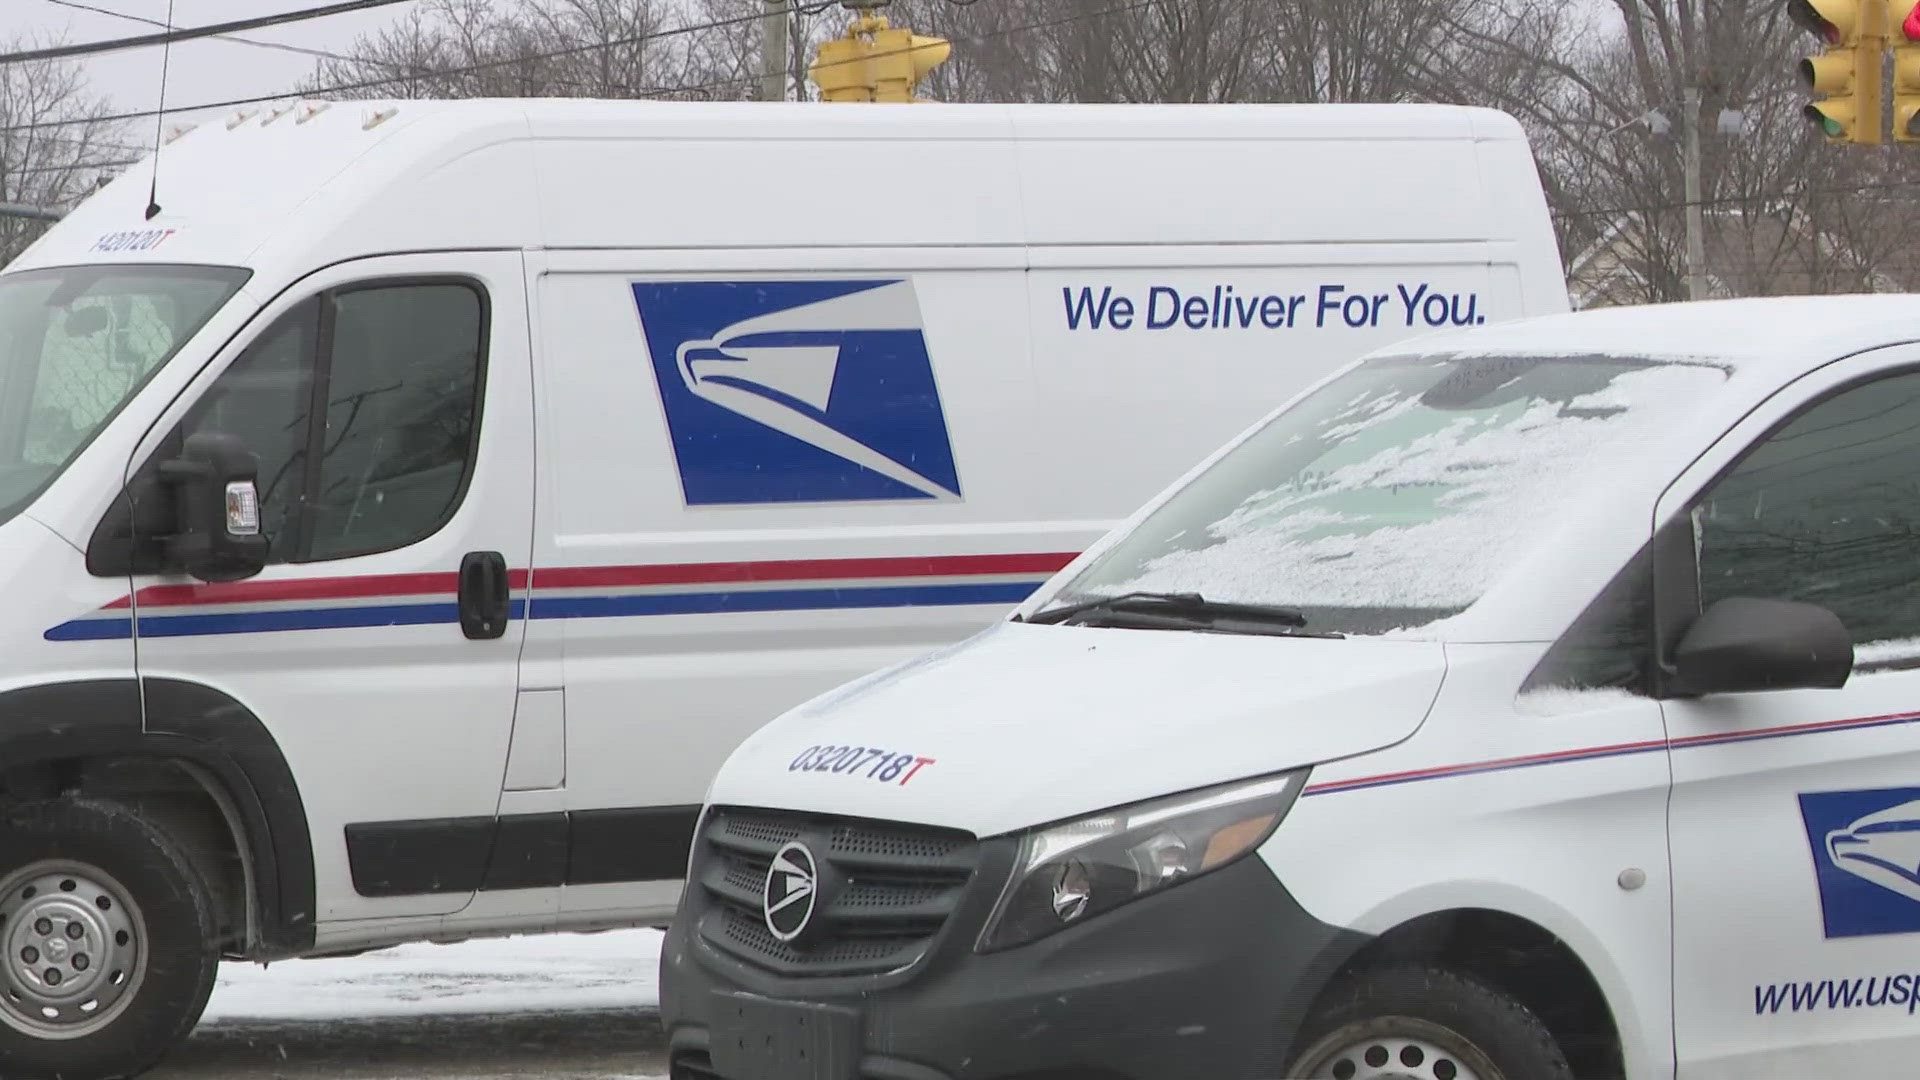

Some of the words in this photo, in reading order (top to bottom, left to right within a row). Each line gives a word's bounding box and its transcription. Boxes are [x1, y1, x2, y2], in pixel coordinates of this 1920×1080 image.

[1062, 286, 1134, 330] We
[1147, 285, 1306, 330] Deliver
[1316, 284, 1389, 328] For
[1397, 283, 1485, 327] You.
[788, 745, 936, 786] 0320718T
